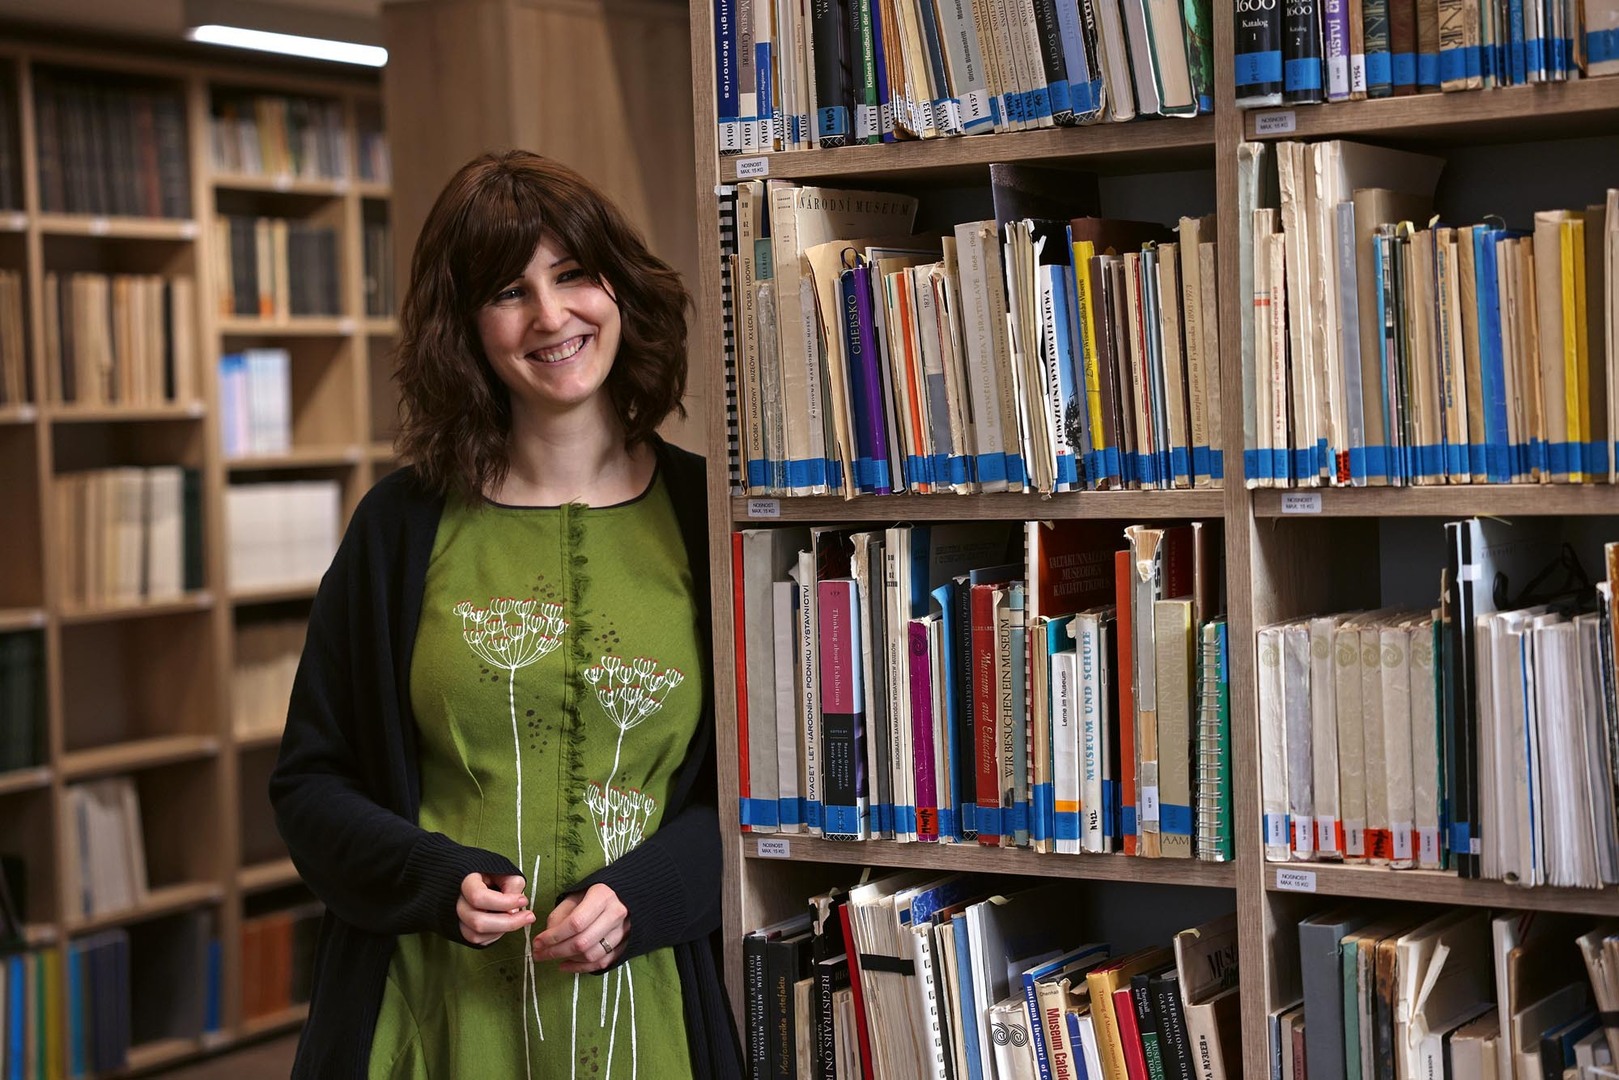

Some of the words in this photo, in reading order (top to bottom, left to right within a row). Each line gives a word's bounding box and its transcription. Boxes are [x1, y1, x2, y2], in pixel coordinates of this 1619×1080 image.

[1242, 18, 1268, 28] Katalog
[1287, 6, 1312, 16] 1600
[961, 30, 972, 63] Blumentritt
[1047, 33, 1061, 71] SOCIETY
[722, 40, 730, 98] Memories
[966, 64, 975, 81] Ulrich
[923, 103, 932, 126] M133
[941, 104, 950, 128] M135
[970, 93, 979, 117] M137
[800, 194, 850, 212] NÁRODNÍ
[856, 200, 909, 216] MUSEUM
[1078, 278, 1086, 301] Museen
[849, 294, 861, 354] CHEBSKO
[1048, 336, 1058, 380] WYSTAWA
[1191, 363, 1198, 372] na
[802, 584, 811, 646] VÝSTAVNICTVÍ
[1001, 618, 1011, 667] MUSEUM
[1083, 631, 1092, 680] SCHULE
[981, 649, 992, 697] Museums
[1002, 670, 1011, 690] EIN
[982, 702, 992, 721] and
[1061, 698, 1067, 706] im
[1084, 685, 1093, 714] UND
[1003, 692, 1013, 752] BESUCHEN
[983, 725, 993, 773] Education
[1085, 720, 1095, 781] MUSEUM
[1004, 755, 1013, 777] WIR
[1163, 836, 1189, 845] AAM
[750, 987, 756, 996] BY
[776, 976, 786, 1013] artefaktu
[1141, 988, 1150, 1012] Chenhall
[822, 975, 832, 1047] REGISTRARS
[1026, 985, 1038, 1020] national
[1033, 1023, 1045, 1060] thesauri
[1168, 992, 1184, 1058] INTERNATIONAL
[1046, 1007, 1063, 1050] Museum
[1104, 1020, 1114, 1042] Museum
[1163, 1017, 1172, 1044] EDSON
[779, 1017, 788, 1074] Morfometrika
[825, 1050, 834, 1070] ON
[1144, 1042, 1152, 1058] AND
[1151, 1040, 1161, 1071] MUSEUM
[1200, 1041, 1210, 1070] МУЗЕЕВ
